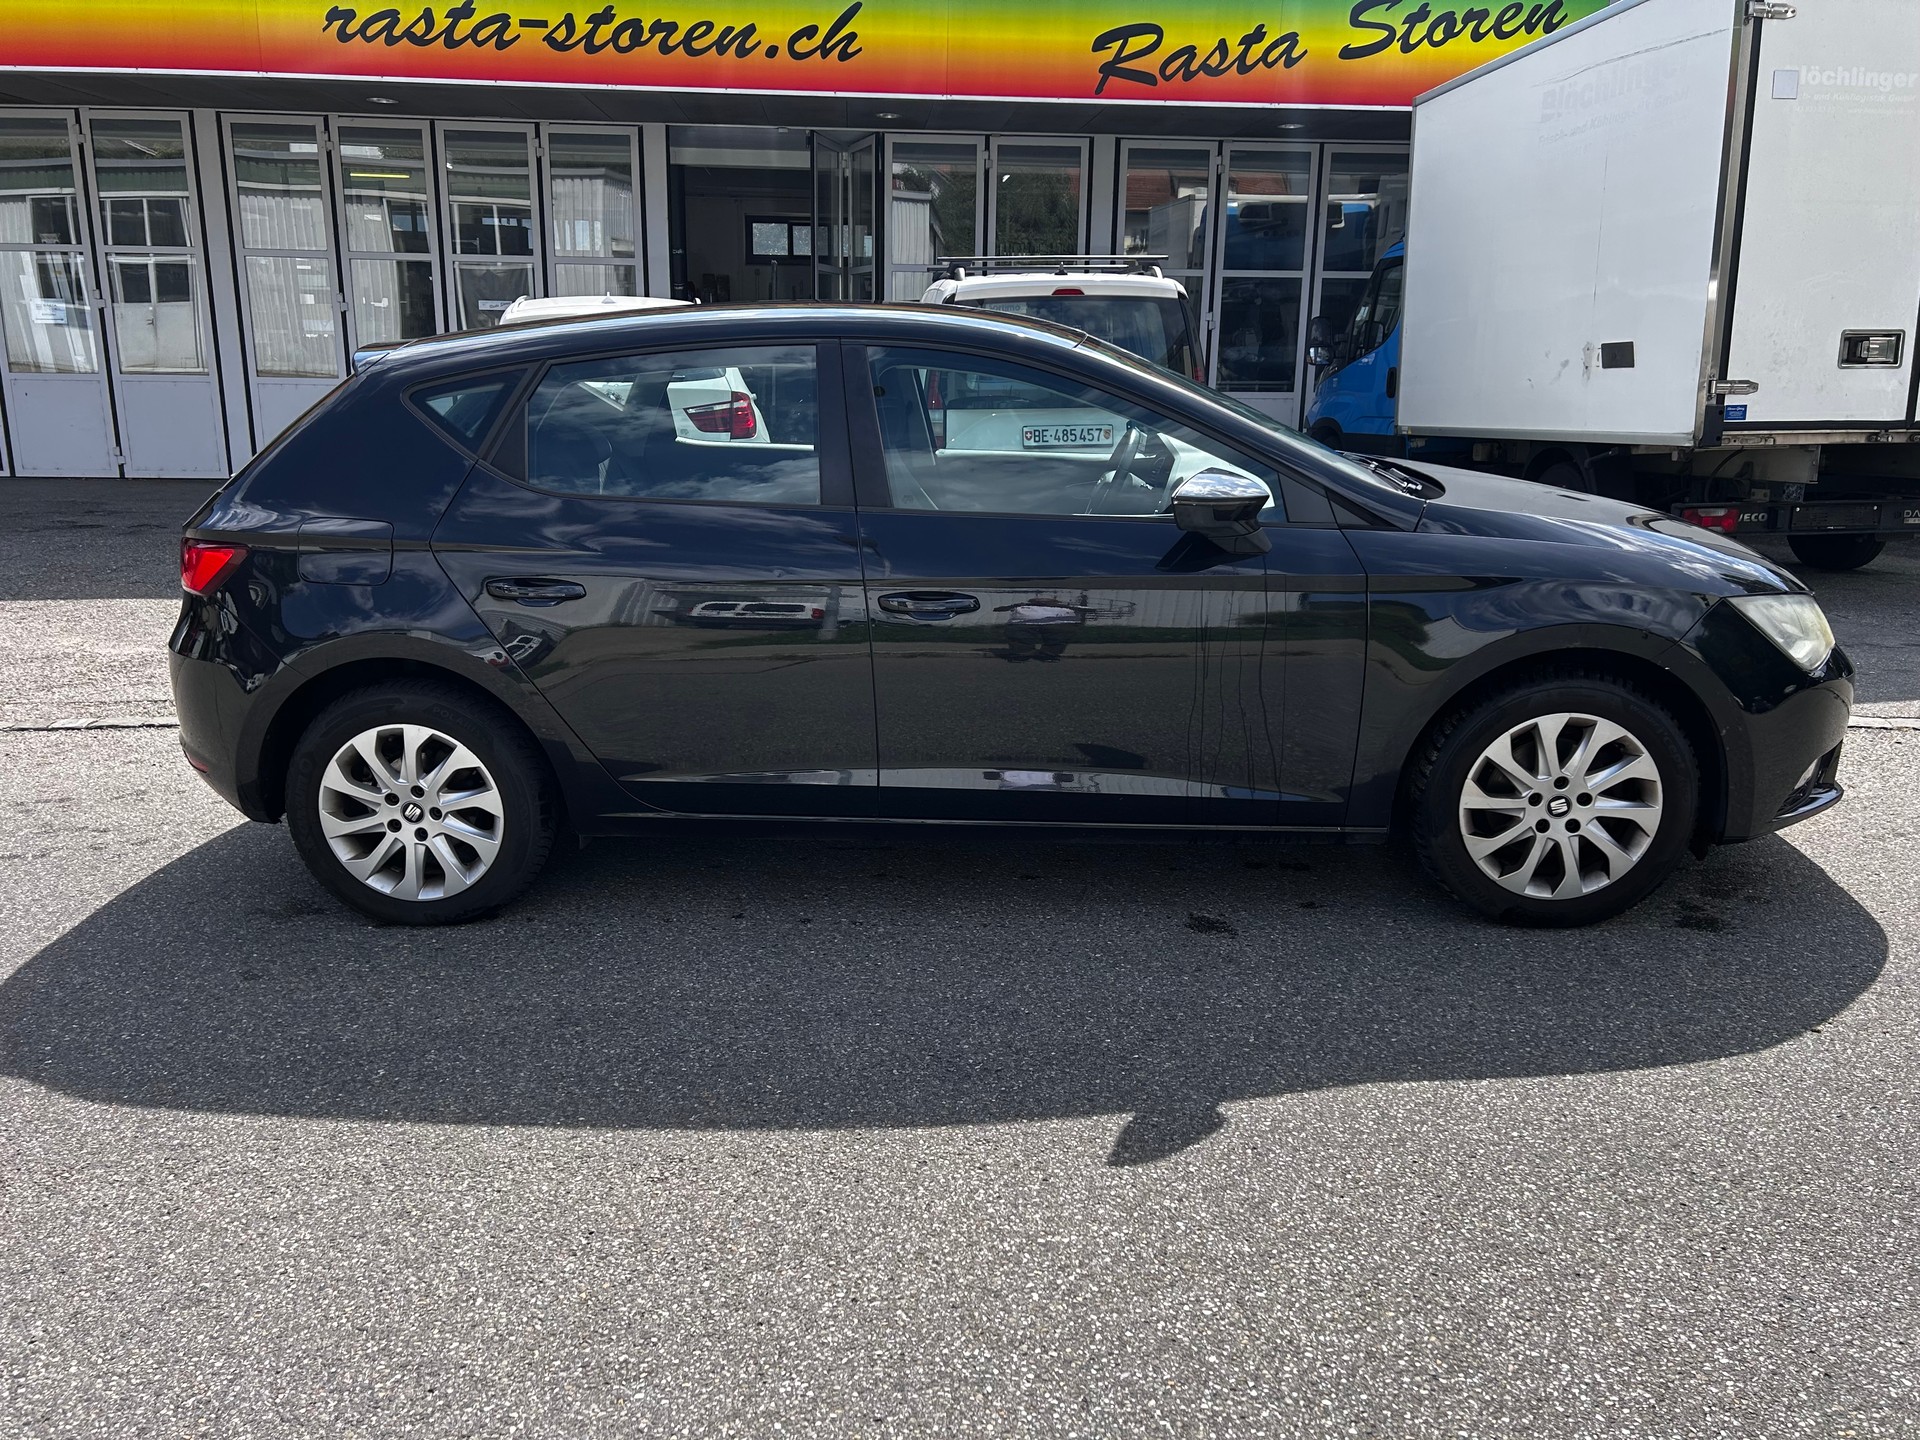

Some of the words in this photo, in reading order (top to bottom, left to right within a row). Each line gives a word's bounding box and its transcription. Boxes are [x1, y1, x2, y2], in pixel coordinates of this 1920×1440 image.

[322, 0, 863, 62] rasta-storen.ch
[1092, 22, 1309, 95] Rasta
[1338, 0, 1568, 60] Storen
[1787, 65, 1918, 92] löchlinger
